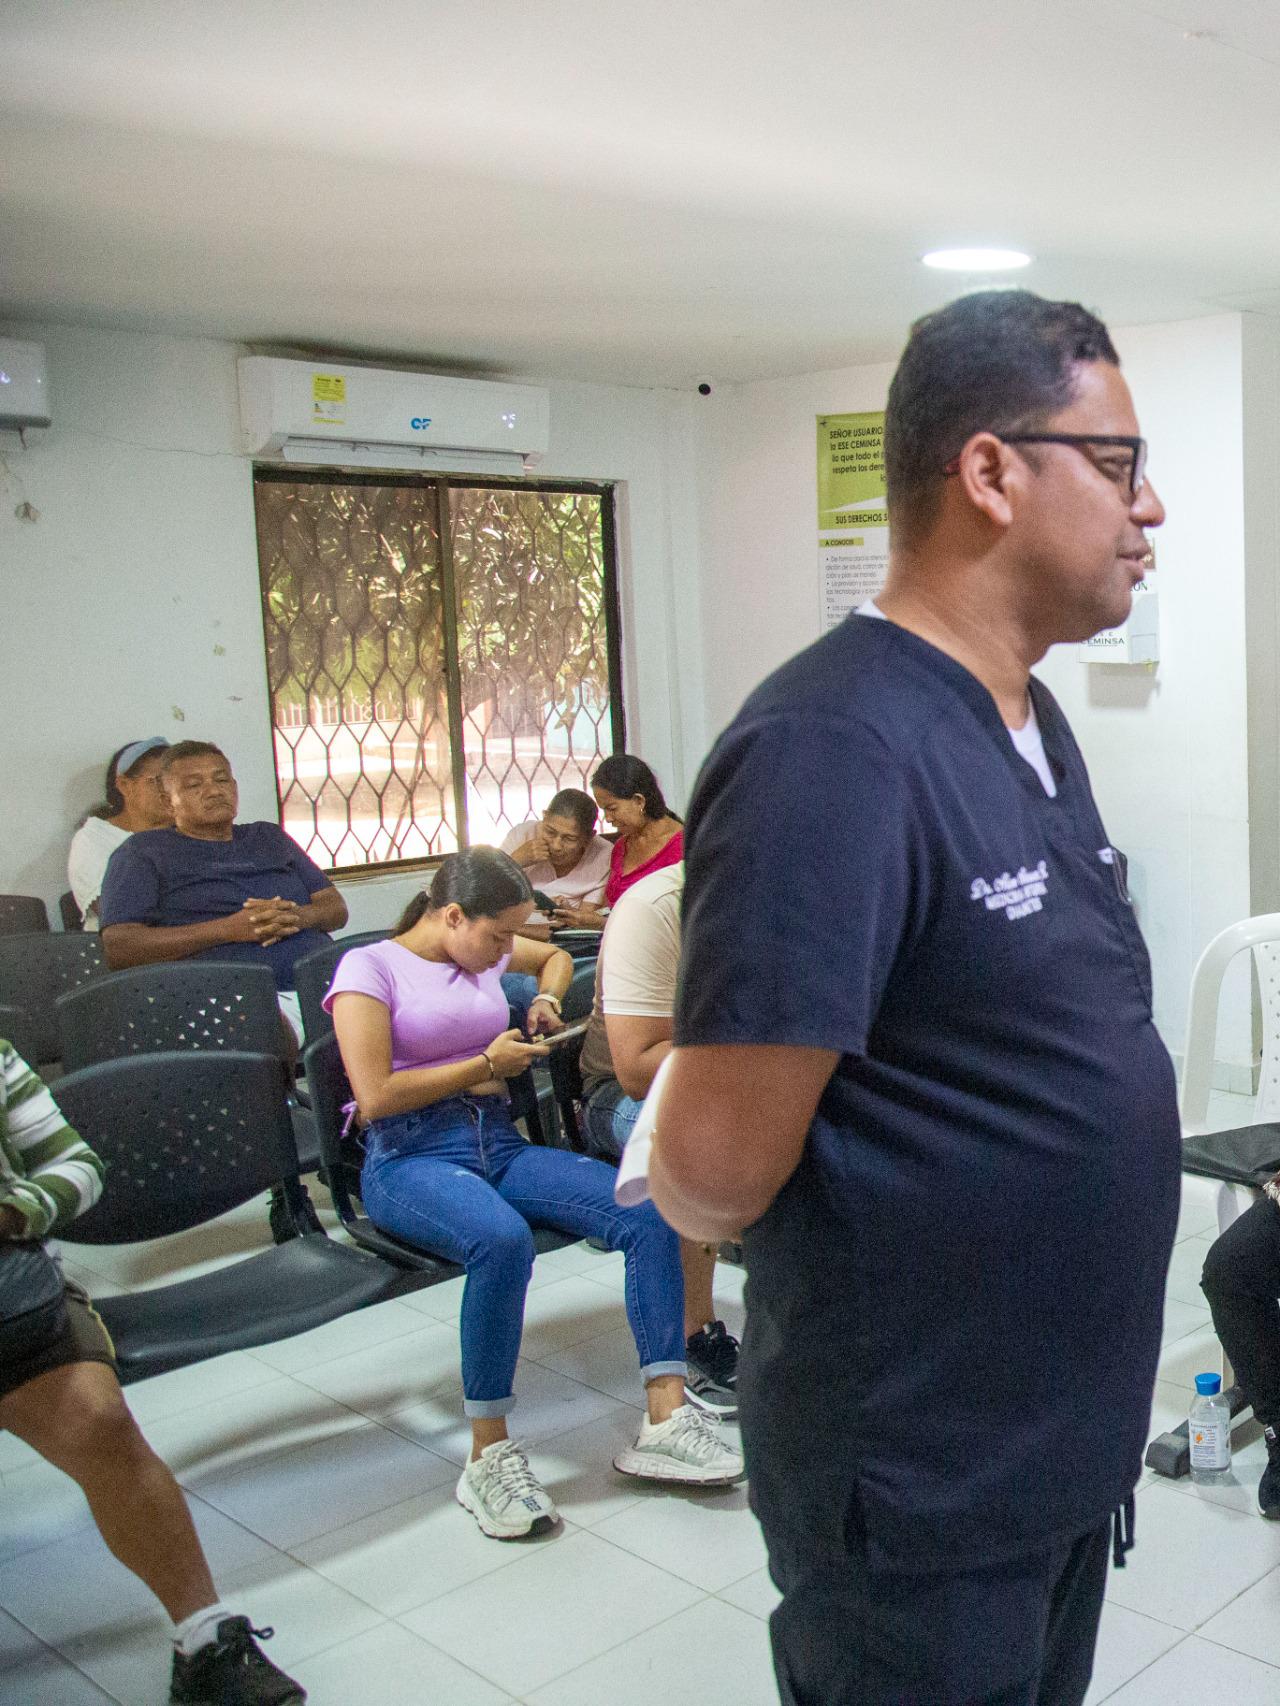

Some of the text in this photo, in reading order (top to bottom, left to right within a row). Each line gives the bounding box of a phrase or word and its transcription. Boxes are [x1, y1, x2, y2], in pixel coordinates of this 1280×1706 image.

[830, 426, 883, 440] SEÑOR USUARIO
[838, 441, 849, 450] ESE
[850, 439, 881, 449] CEMINSA
[840, 454, 854, 463] que
[855, 451, 871, 461] todo
[873, 451, 879, 459] el
[832, 465, 857, 474] respeta
[858, 464, 868, 472] los
[836, 515, 847, 524] SUS
[848, 513, 882, 523] DERECHOS
